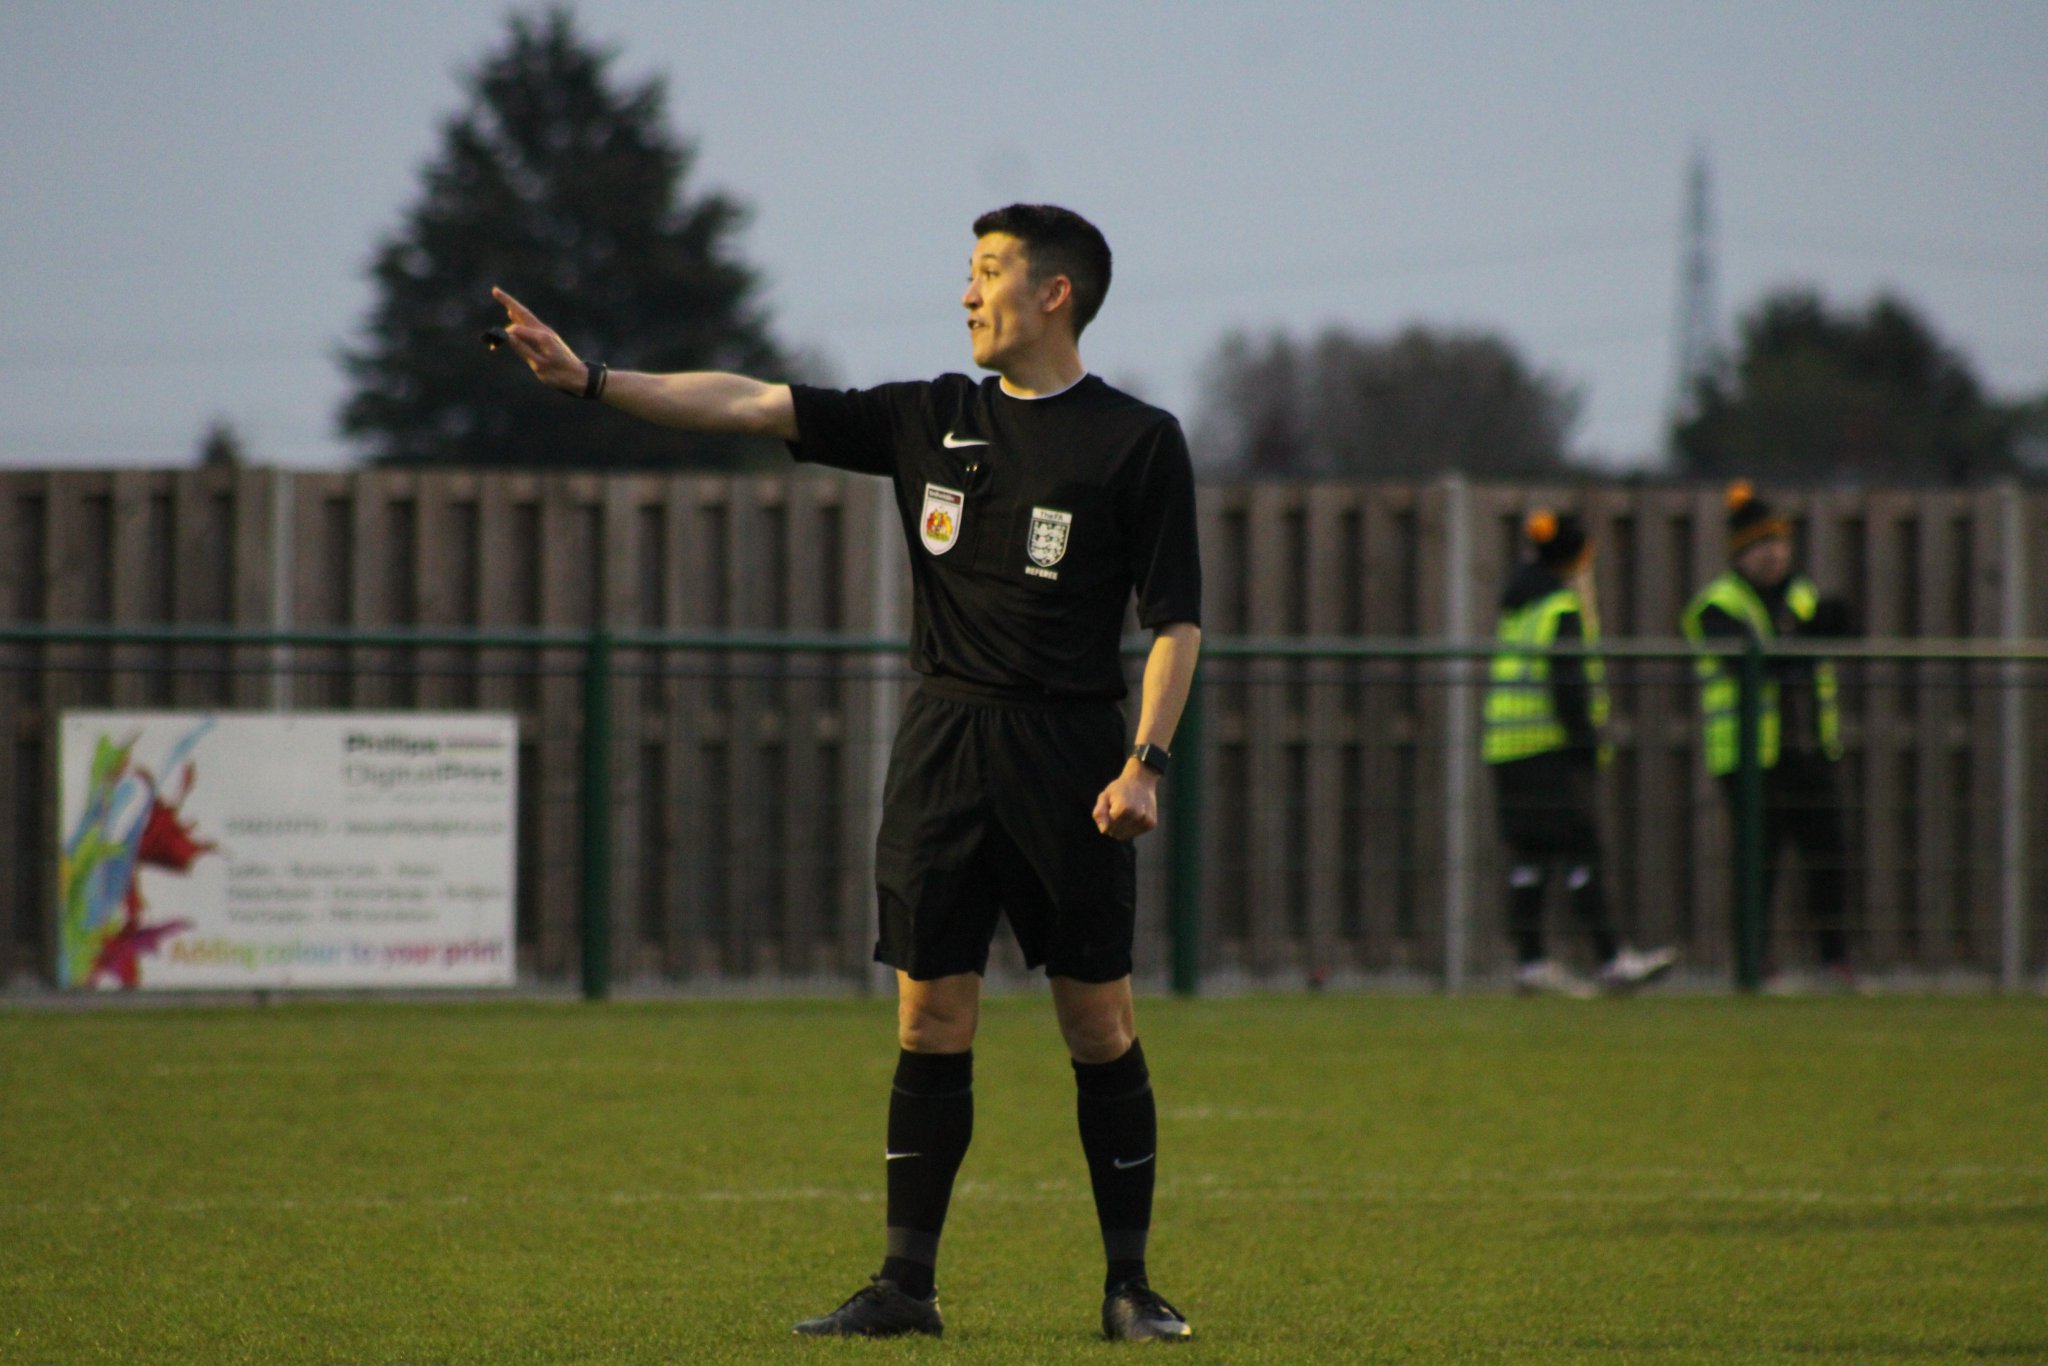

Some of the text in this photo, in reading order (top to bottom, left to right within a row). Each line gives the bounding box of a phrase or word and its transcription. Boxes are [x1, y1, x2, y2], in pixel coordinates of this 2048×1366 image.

[1025, 566, 1059, 581] REFEREE
[171, 936, 503, 972] Adding colour to your print
